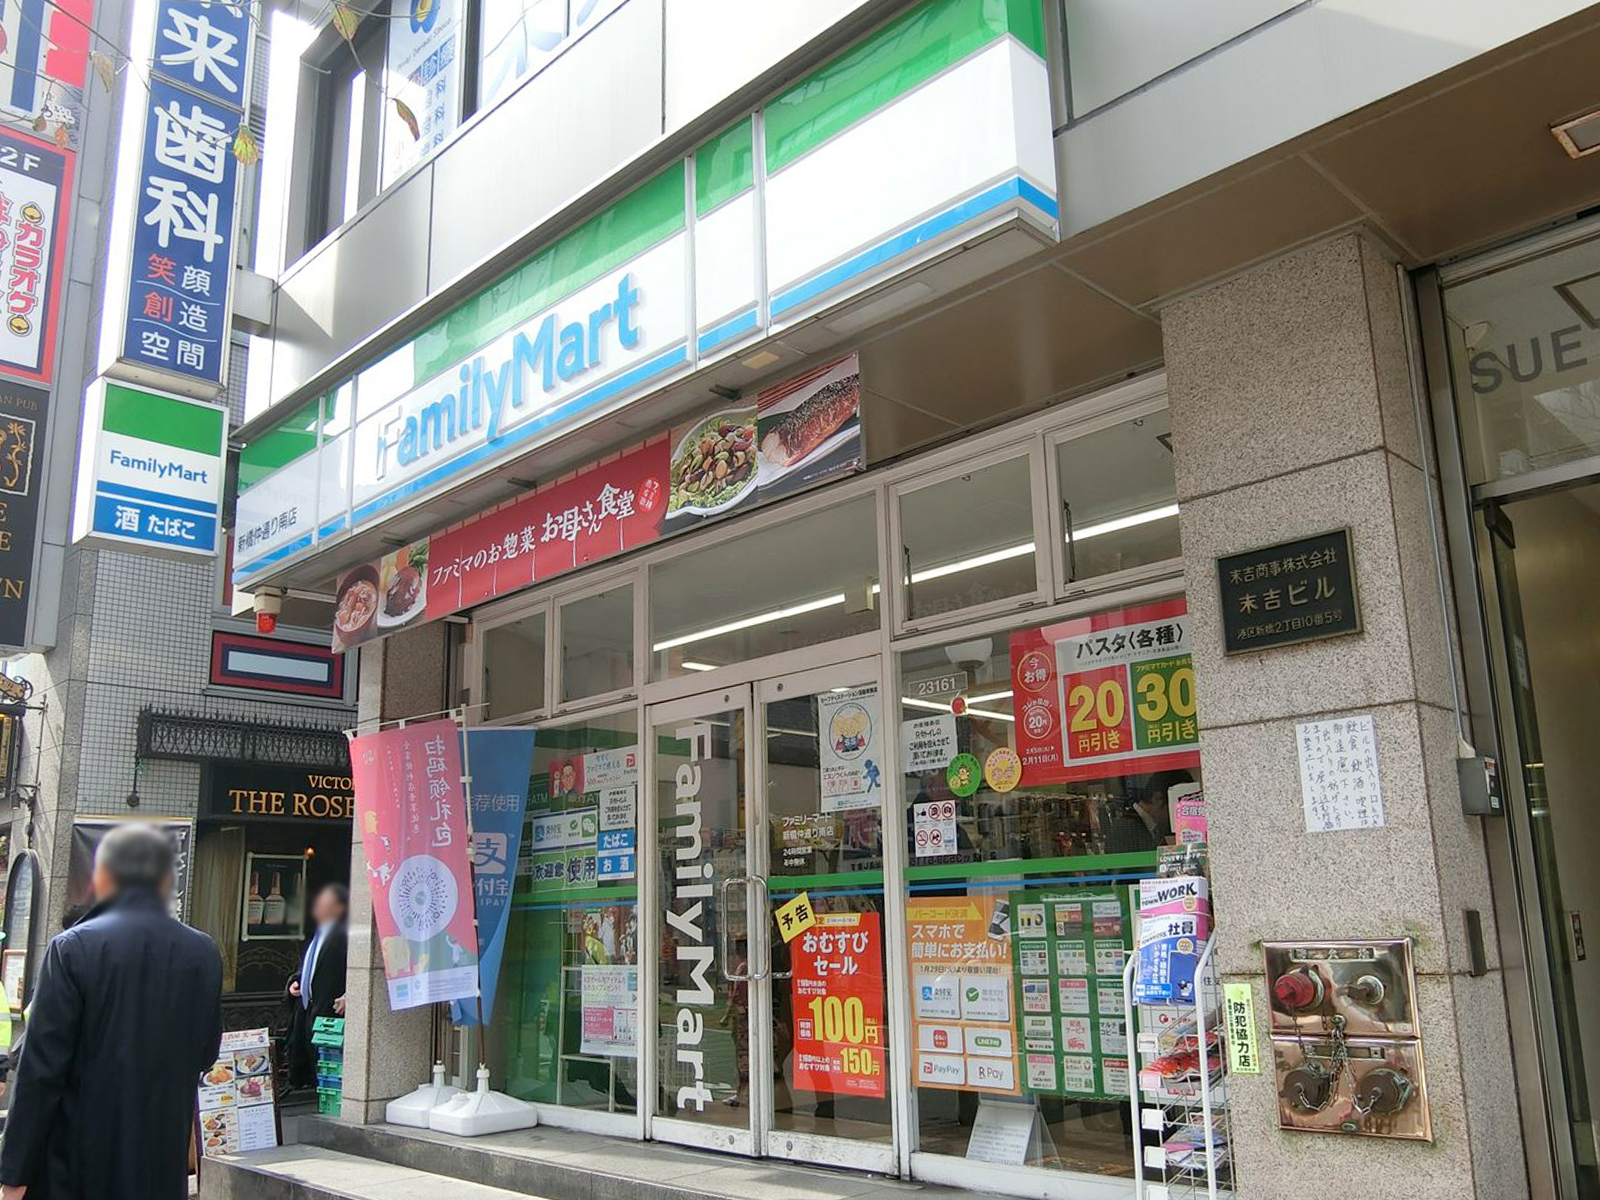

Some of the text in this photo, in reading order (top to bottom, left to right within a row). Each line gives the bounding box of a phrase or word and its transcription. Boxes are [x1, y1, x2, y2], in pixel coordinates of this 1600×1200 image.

[8, 220, 46, 315] カラオケ
[147, 253, 211, 297] 笑顔
[143, 291, 208, 334] 創造
[140, 331, 205, 371] 空間
[1469, 325, 1588, 394] SUE
[376, 271, 639, 480] FamilyMart
[110, 450, 208, 485] FamilyMart
[115, 505, 196, 541] 酒 たばこ
[237, 506, 298, 553] 新橋仲通り南店
[432, 525, 536, 587] ファミマのお惣菜
[540, 483, 636, 542] お母さん食堂
[1077, 623, 1184, 659] パスタ〈各種〉
[918, 677, 957, 696] 23161
[1024, 669, 1046, 683] お得
[1069, 679, 1125, 732] 20
[1136, 667, 1196, 722] 30
[1079, 730, 1121, 753] 円引き
[1147, 719, 1196, 743] 円引き
[308, 775, 354, 790] VICTO
[228, 790, 285, 814] THE
[781, 814, 831, 828] ファミリーマート
[602, 833, 629, 849] たばこ
[602, 856, 630, 873] お酒
[475, 878, 508, 897] 付宝
[1157, 882, 1198, 903] WORK
[666, 723, 714, 1112] FamilyMart
[781, 903, 809, 931] 予告
[1167, 921, 1194, 936] 社員
[802, 931, 869, 954] おむすび
[911, 923, 965, 940] スマホで
[911, 941, 1008, 960] 簡単にお支払い!
[813, 955, 858, 976] セール
[1233, 1002, 1251, 1068] 防犯協力店
[934, 1064, 960, 1075] PayPay
[987, 1068, 1004, 1081] Pay
